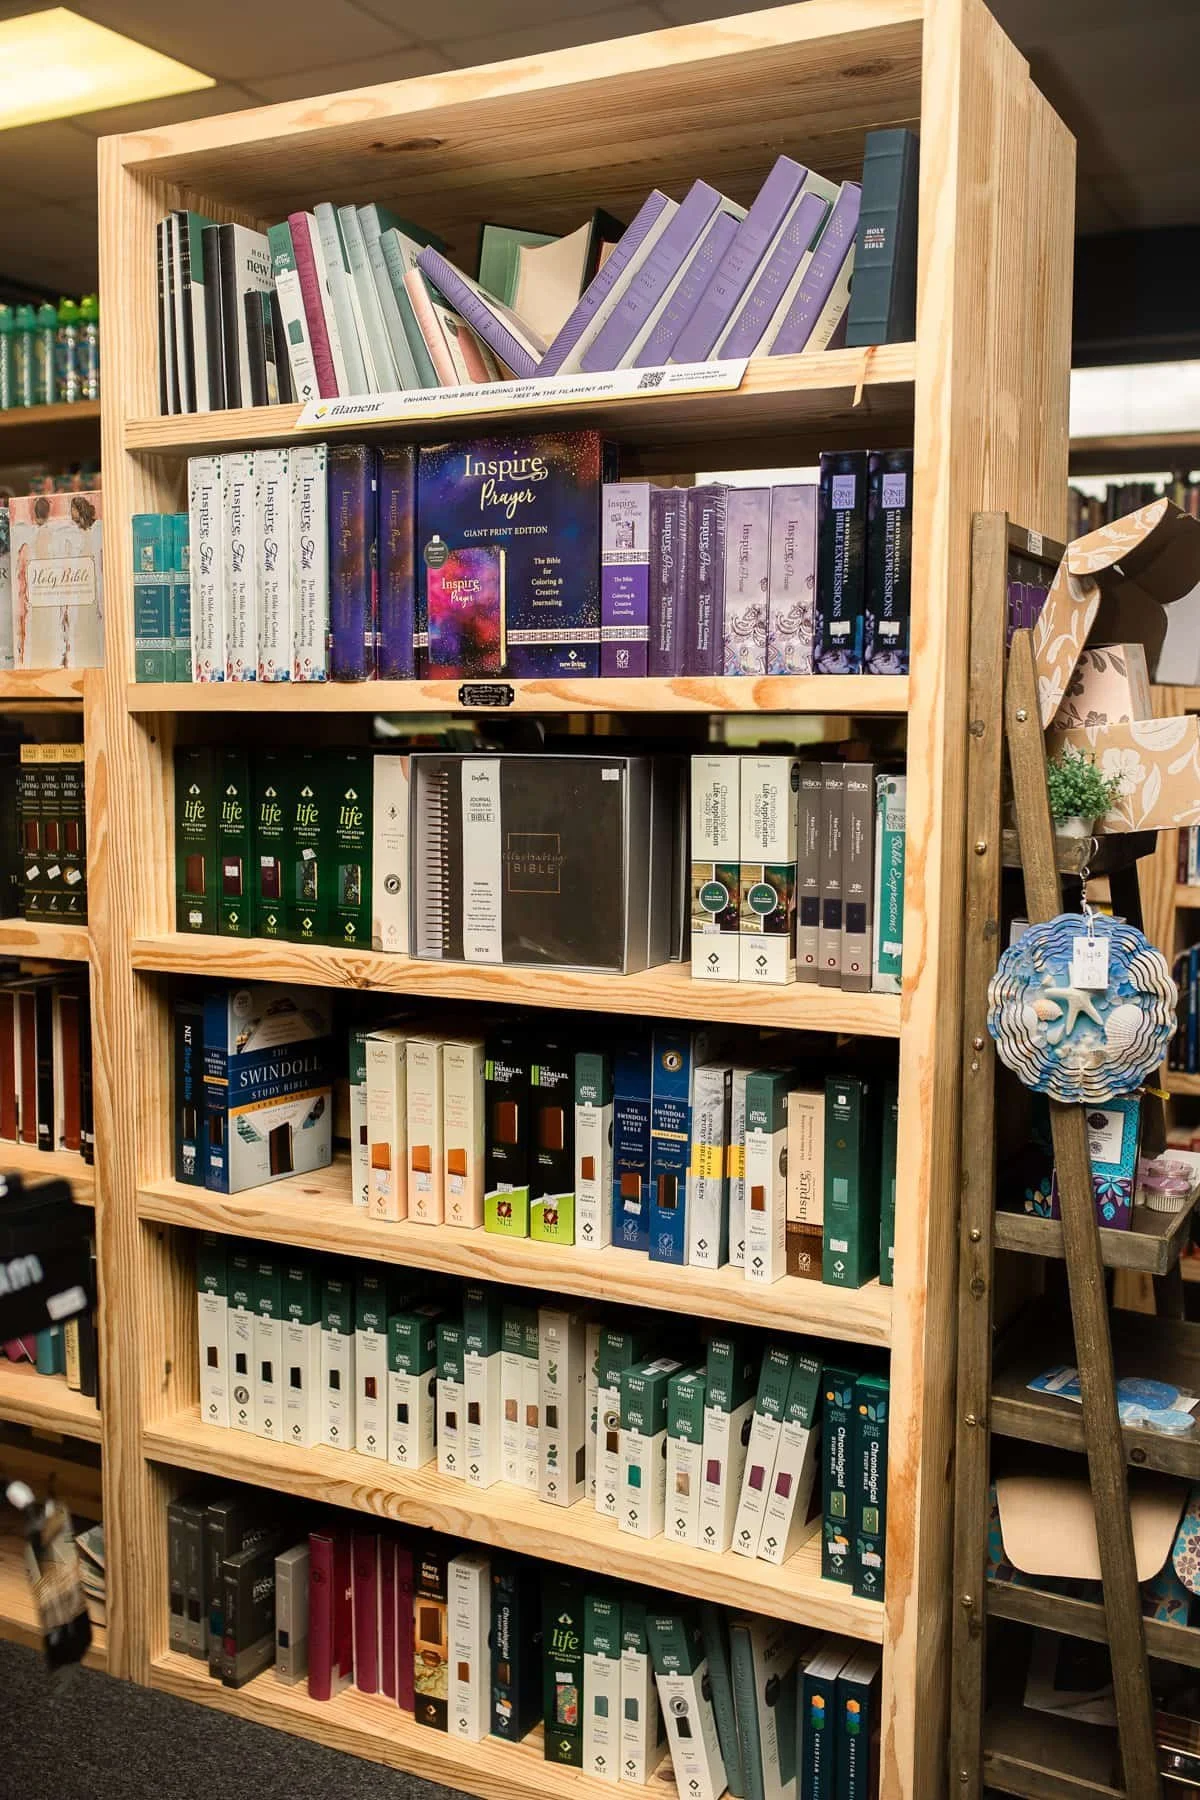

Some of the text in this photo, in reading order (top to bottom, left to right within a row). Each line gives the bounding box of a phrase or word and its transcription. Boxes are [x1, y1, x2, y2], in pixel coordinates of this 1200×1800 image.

[247, 259, 269, 275] new
[403, 385, 536, 404] ENHANCE YOUR BIBLE READING WITH
[558, 386, 596, 395] FILAMENT
[330, 402, 382, 416] filament
[464, 450, 548, 481] Inspire
[480, 478, 536, 520] Prayer
[199, 485, 214, 575] Inspire Faith
[231, 482, 245, 573] Inspire Faith
[264, 479, 278, 572] Inspire Faith
[300, 477, 315, 571] Inspire Faith
[464, 526, 548, 538] GIANT PRINT EDITION
[662, 511, 675, 553] Inspire
[699, 508, 713, 551] Inspire
[740, 524, 752, 561] Inspire
[784, 520, 798, 562] Inspire
[843, 510, 851, 585] CHRONOLOGICAL
[533, 557, 544, 565] The
[833, 511, 845, 617] BIBLE EXPRESSIONS
[884, 511, 895, 617] BIBLE EXPRESSIONS
[32, 567, 89, 589] Holy Bible
[543, 567, 552, 575] for
[441, 576, 481, 592] Inspire
[531, 578, 557, 587] Coloring
[450, 590, 473, 608] Prayer
[535, 588, 560, 596] Creative
[532, 598, 562, 607] Journaling
[704, 792, 712, 816] Study
[184, 801, 206, 824] life
[222, 801, 242, 824] life
[261, 803, 281, 826] life
[296, 803, 319, 826] life
[339, 806, 363, 829] life
[471, 813, 490, 821] BIBLE
[711, 782, 721, 847] Life Application
[720, 785, 729, 842] Chronological
[761, 783, 770, 848] Life Application
[769, 785, 778, 843] Chronological
[892, 835, 903, 867] Bible
[513, 863, 556, 874] BIBLE
[887, 868, 902, 933] Expressions
[184, 1025, 192, 1045] NLT
[240, 1056, 320, 1088] SWINDOLL
[494, 1066, 523, 1075] PARALLEL
[540, 1071, 568, 1080] PARALLEL
[251, 1079, 309, 1099] STUDY BIBLE
[617, 1113, 648, 1121] SWINDOLL
[654, 1109, 685, 1118] SWINDOLL
[796, 1170, 811, 1220] Inspire
[497, 1217, 513, 1227] NLT
[544, 1224, 559, 1234] NLT
[695, 1251, 709, 1259] NLT
[752, 1269, 765, 1277] NLT
[833, 1271, 845, 1279] NLT
[712, 1341, 730, 1350] LARGE
[712, 1348, 729, 1356] PRINT
[770, 1356, 788, 1366] PRINT
[771, 1350, 789, 1360] LARGE
[800, 1357, 818, 1368] LARGE
[800, 1363, 817, 1374] PRINT
[677, 1385, 694, 1393] GIANT
[677, 1391, 694, 1399] PRINT
[837, 1427, 846, 1488] Chronological
[870, 1441, 879, 1503] Chronological
[627, 1520, 639, 1529] NLT
[674, 1529, 687, 1537] NLT
[704, 1537, 716, 1545] NLT
[737, 1540, 750, 1549] NLT
[764, 1546, 777, 1556] NLT
[422, 1562, 438, 1573] Every
[422, 1570, 440, 1581] Man's
[831, 1567, 845, 1575] NLT
[862, 1583, 876, 1593] NLT
[502, 1606, 510, 1660] Chronological
[552, 1629, 579, 1652] life
[624, 1770, 637, 1778] NLT
